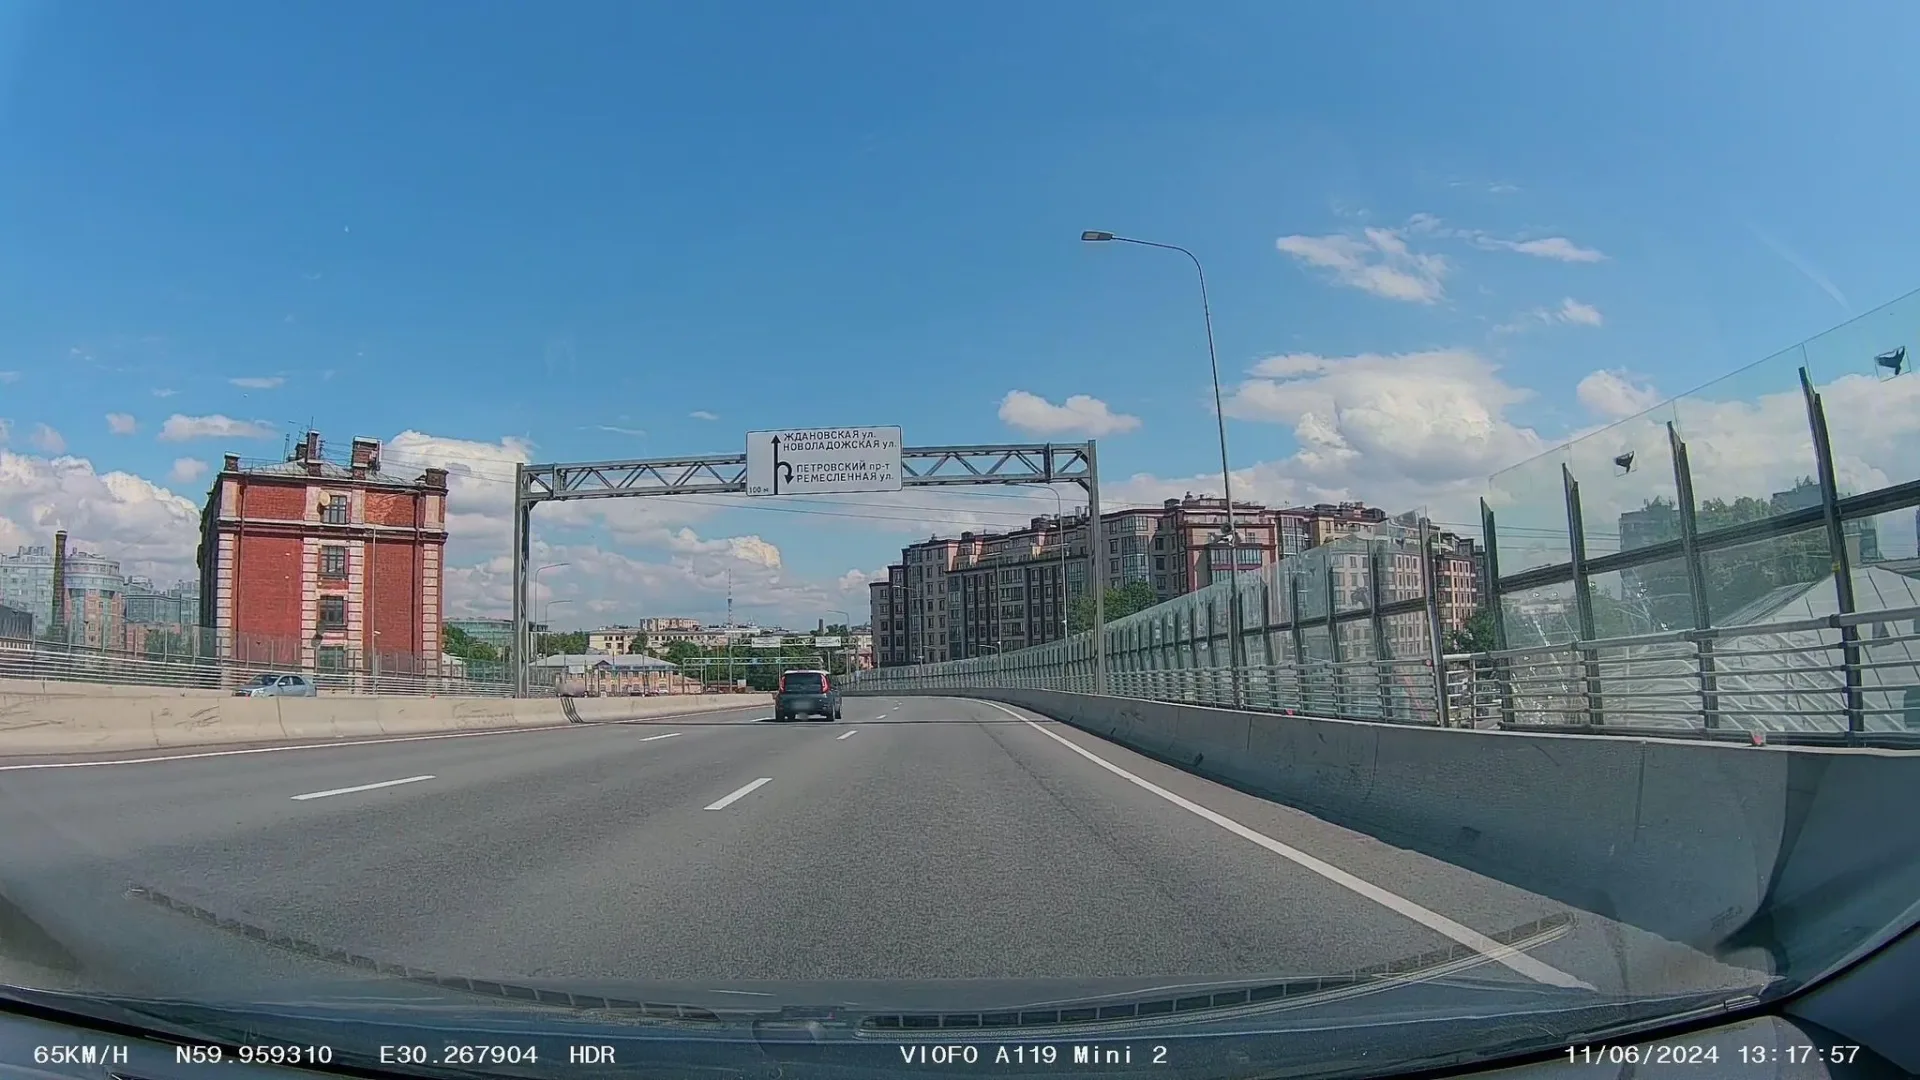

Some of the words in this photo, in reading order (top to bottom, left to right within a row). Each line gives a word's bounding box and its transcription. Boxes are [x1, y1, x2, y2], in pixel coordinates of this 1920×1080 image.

[784, 430, 859, 441] ЖДАНОВСКАЯ
[783, 440, 880, 451] НОВОЛАДОЖСКАЯ
[883, 441, 896, 449] ул.
[797, 460, 866, 472] ПЕТРОВСКИЙ
[797, 473, 877, 483] РЕМЕСЛЕННАЯ
[880, 473, 894, 482] ул.
